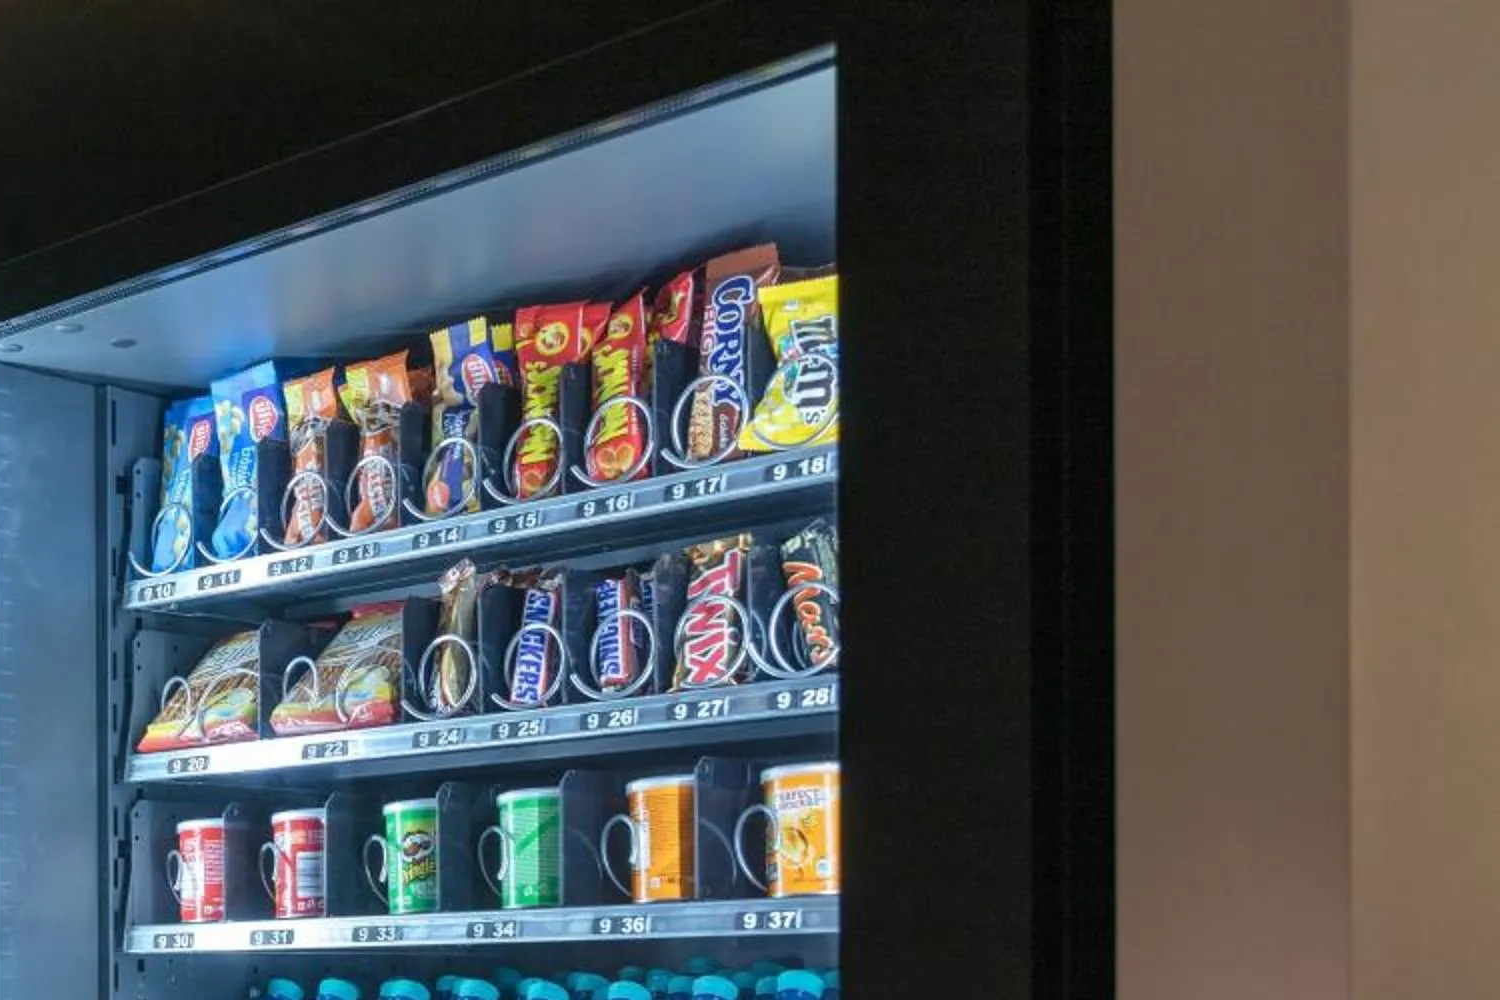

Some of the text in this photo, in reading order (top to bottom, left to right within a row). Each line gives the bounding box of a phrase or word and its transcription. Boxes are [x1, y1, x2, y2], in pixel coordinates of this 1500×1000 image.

[707, 274, 754, 412] CORNY
[773, 457, 825, 480] 9 18
[672, 478, 720, 499] 9 17
[584, 495, 629, 516] 9 16
[494, 512, 537, 533] 9 15
[418, 528, 459, 547] 9 14
[338, 545, 374, 563] 9 13
[271, 558, 308, 576] 9 12
[513, 589, 554, 703] SNCKERS
[777, 688, 829, 709] 9 28
[674, 700, 723, 720] 9 27
[588, 711, 633, 728] 9 26
[419, 730, 457, 747] 9 24
[499, 721, 539, 738] 9 25
[307, 742, 343, 759] 9 22
[600, 916, 645, 934] 9 36
[743, 911, 795, 929] 9 37
[255, 930, 288, 945] 9 31
[359, 927, 395, 941] 9 33
[472, 921, 515, 938] 9 34
[157, 934, 189, 948] 9 30
